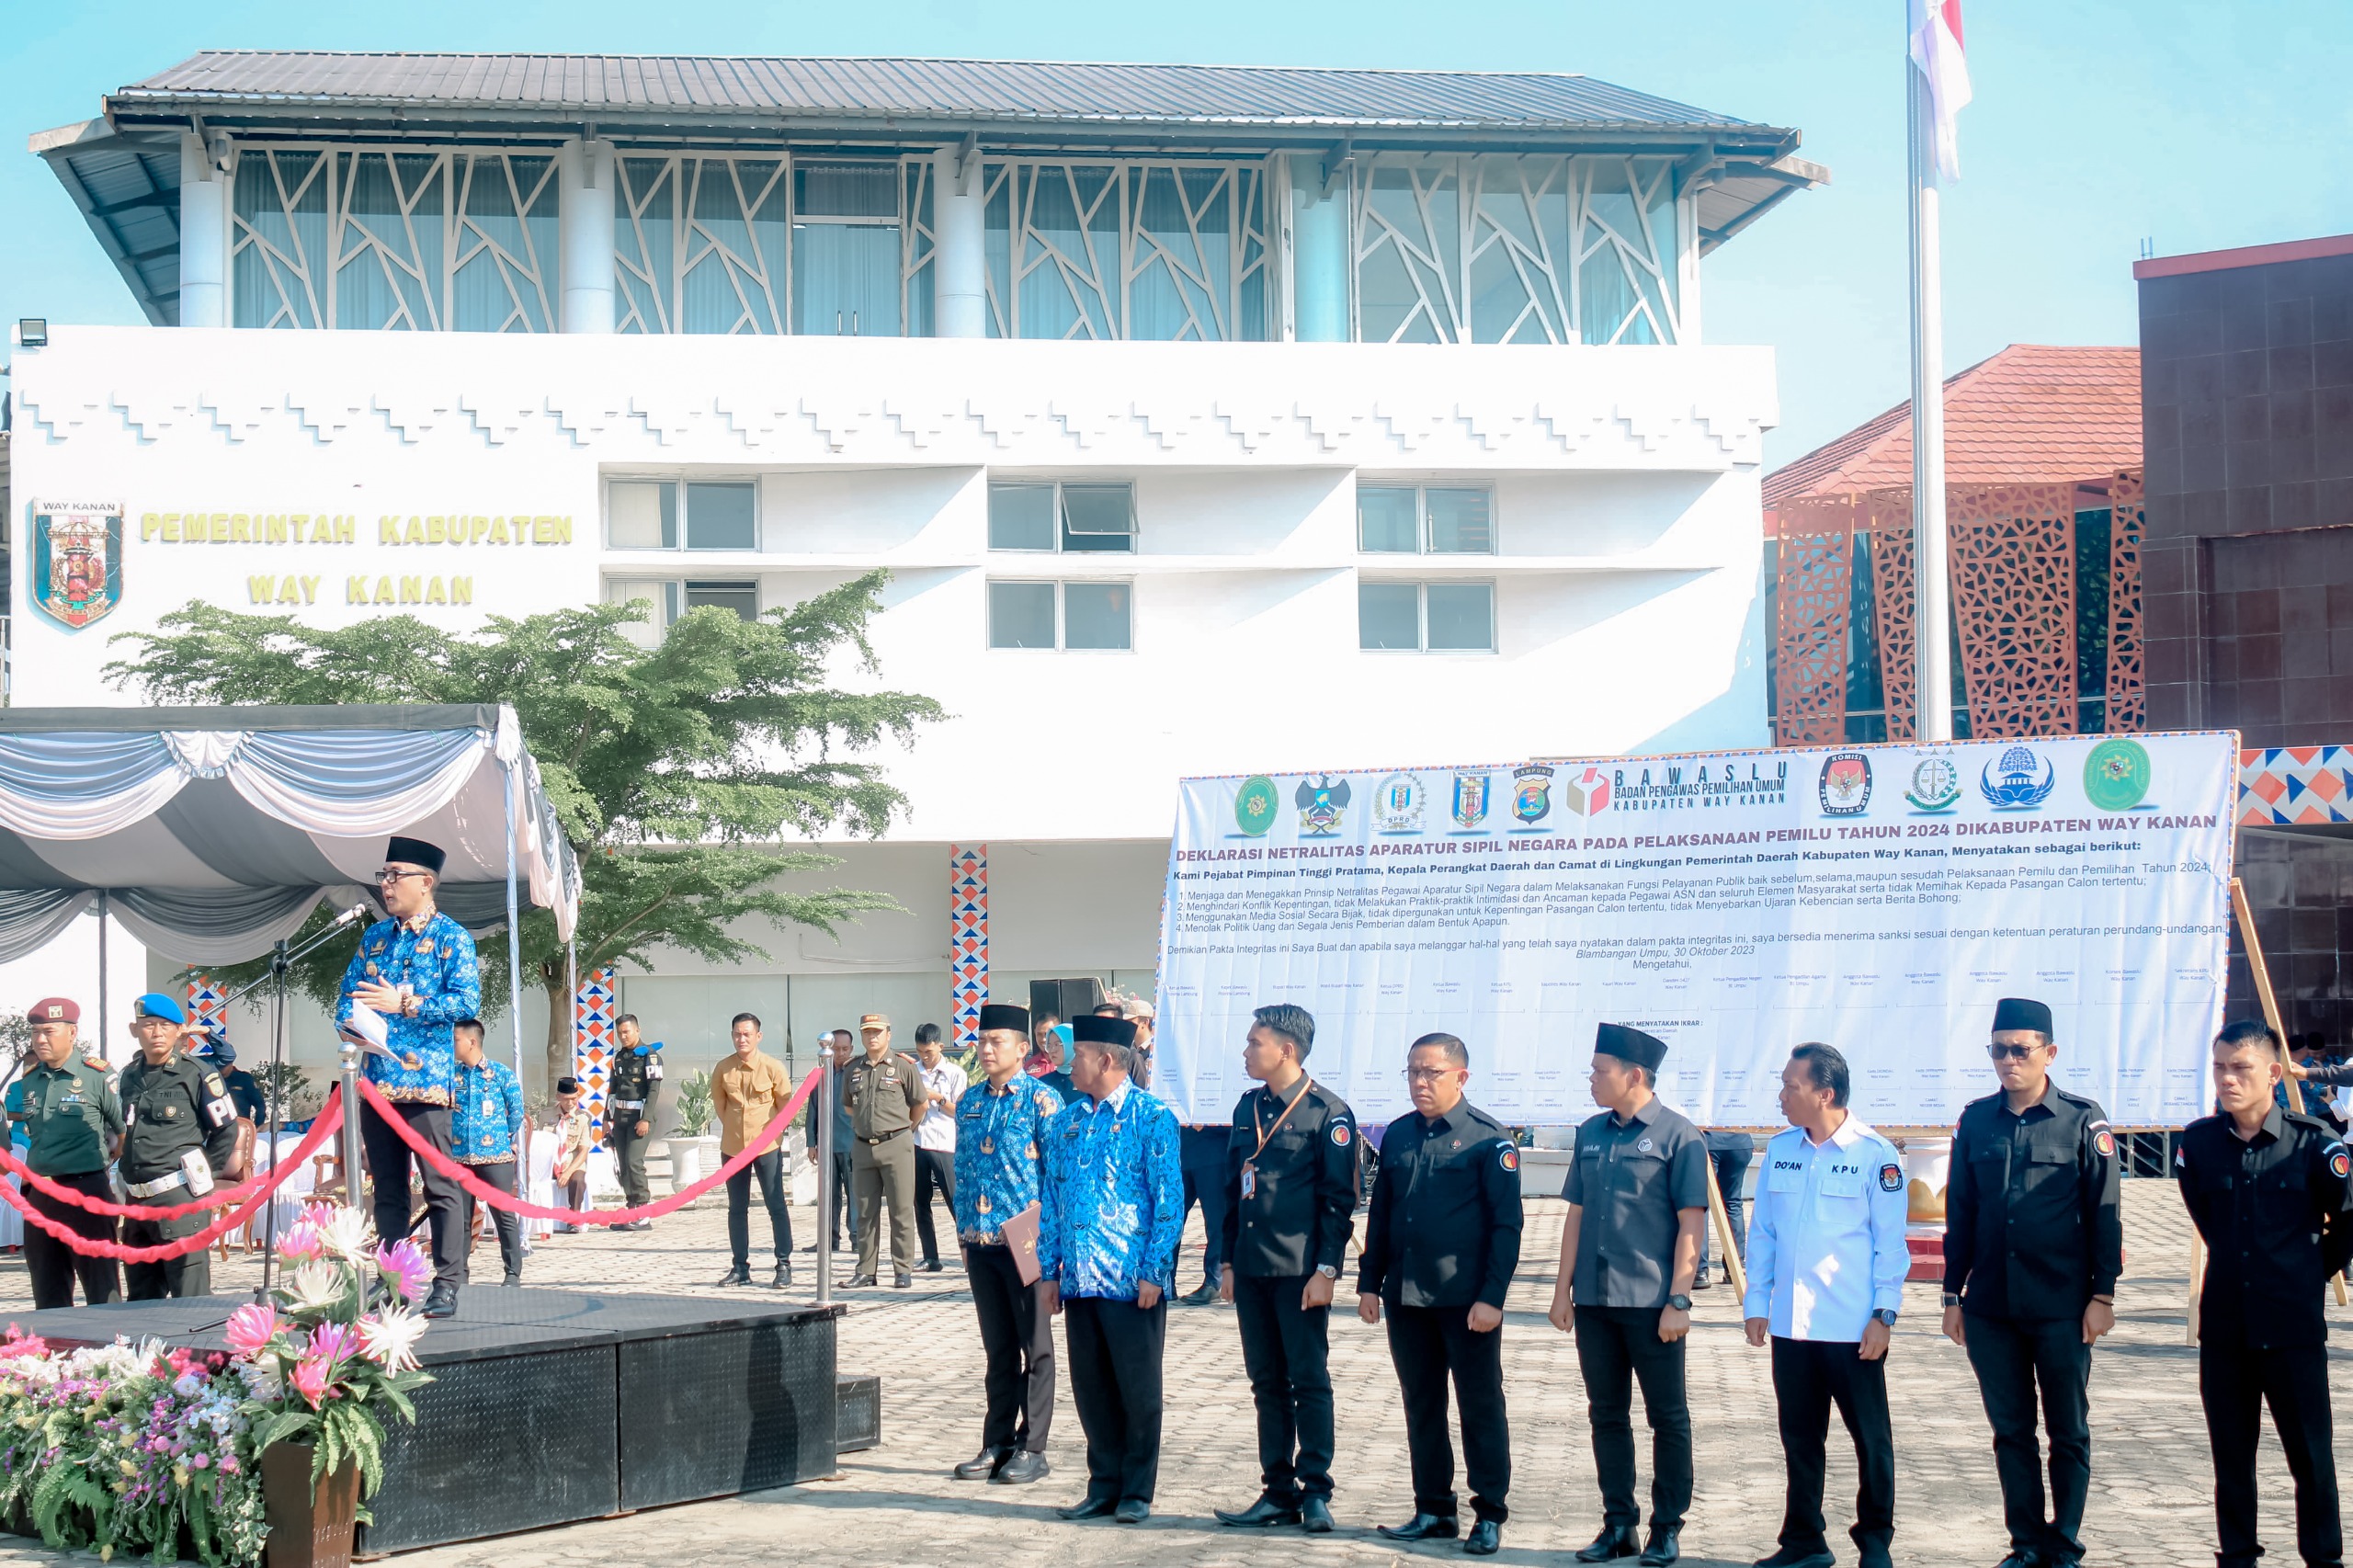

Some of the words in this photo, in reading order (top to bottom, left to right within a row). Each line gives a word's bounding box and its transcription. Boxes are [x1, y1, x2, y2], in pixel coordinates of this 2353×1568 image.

[42, 502, 69, 511] WAY
[73, 503, 116, 511] KANAN
[141, 512, 356, 543] PEMERINTAH
[379, 515, 573, 545] KABUPATEN
[247, 575, 322, 604] WAY
[347, 575, 474, 605] KANAN
[1515, 767, 1553, 777] LAMPUNG
[1832, 754, 1862, 762] KOMISI
[1614, 761, 1787, 787] BAWASLU
[1614, 797, 1694, 811] KABUPATEN
[1703, 795, 1731, 807] WAY
[1739, 792, 1785, 805] KANAN
[1615, 786, 1646, 799] BADAN
[1649, 783, 1699, 797] PENGAWAS
[1702, 780, 1753, 794] PEMILIHAN
[1756, 779, 1785, 791] UMUM
[1820, 789, 1855, 814] PEMILIHAN
[1857, 786, 1871, 812] UMUM
[1176, 848, 1263, 861] DEKLARASI
[1267, 846, 1365, 858] NETRALITAS
[1369, 843, 1457, 856] APARATUR
[1461, 841, 1503, 853] SIPIL
[1507, 838, 1577, 851] NEGARA
[1583, 837, 1629, 849] PADA
[1634, 832, 1760, 847] PELAKSANAAN
[1766, 829, 1832, 842] PEMILU
[1837, 826, 1902, 839] TAHUN
[1906, 824, 1950, 837] 2024
[1956, 820, 2091, 835] DIKABUPATEN
[2097, 818, 2141, 830] WAY
[2147, 816, 2217, 829] KANAN
[1173, 871, 1200, 880] Kami
[1203, 868, 1244, 881] Pejabat
[1246, 867, 1296, 881] Pimpinan
[1299, 866, 1332, 879] Tinggi
[1335, 864, 1384, 877] Pratama,
[1387, 863, 1427, 877] Kepala
[1429, 861, 1487, 875] Perangkat
[1490, 860, 1530, 871] Daerah
[1533, 859, 1555, 869] dan
[1558, 858, 1597, 869] Camat
[1614, 856, 1682, 870] Lingkungan
[1686, 853, 1753, 865] Pemerintah
[1756, 851, 1799, 862] Daerah
[1802, 848, 1870, 863] Kabupaten
[1873, 847, 1900, 861] Way
[1904, 846, 1948, 858] Kanan,
[1951, 843, 2030, 858] Menyatakan
[2034, 841, 2086, 855] sebagai
[2090, 840, 2142, 851] berikut:
[1187, 901, 1240, 913] Menghindari
[1243, 900, 1271, 909] Konflik
[1335, 898, 1355, 907] tidak
[1358, 896, 1406, 906] Melakukan
[1409, 895, 1473, 908] Praktik-praktik
[1476, 894, 1519, 903] Intimidasi
[1543, 892, 1588, 902] Ancaman
[1591, 891, 1626, 903] kepada
[1629, 890, 1670, 903] Pegawai
[1673, 889, 1696, 898] ASN
[1720, 887, 1755, 897] seluruh
[1757, 886, 1794, 896] Elemen
[1798, 884, 1857, 897] Masyarakat
[1888, 882, 1912, 892] tidak
[1915, 881, 1962, 891] Memihak
[1966, 880, 2006, 892] Kepada
[2010, 878, 2063, 891] Pasangan
[2067, 877, 2098, 886] Calon
[1188, 890, 1224, 903] Menjaga
[1245, 888, 1302, 901] Menegakkan
[1304, 887, 1334, 899] Prinsip
[1336, 886, 1379, 896] Netralitas
[1381, 885, 1420, 897] Pegawai
[1423, 884, 1461, 896] Aparatur
[1465, 883, 1484, 895] Sipil
[1486, 882, 1520, 894] Negara
[1555, 880, 1624, 891] Melaksanakan
[1627, 879, 1659, 891] Fungsi
[1662, 877, 1712, 890] Pelayanan
[1716, 876, 1745, 885] Publik
[1901, 869, 1944, 880] sesudah
[1947, 867, 2015, 878] Pelaksanaan
[2018, 866, 2054, 876] Pemilu
[2082, 864, 2134, 874] Pemilihan
[2143, 863, 2177, 872] Tahun
[1186, 911, 1247, 924] Menggunakan
[1249, 910, 1276, 920] Media
[1279, 910, 1305, 919] Sosial
[1308, 909, 1339, 918] Secara
[1369, 908, 1390, 917] tidak
[1392, 906, 1454, 919] dipergunakan
[1484, 904, 1543, 917] Kepentingan
[1546, 903, 1594, 915] Pasangan
[1597, 903, 1625, 912] Calon
[1670, 901, 1692, 910] tidak
[1696, 898, 1761, 912] Menyebarkan
[1765, 897, 1796, 910] Ujaran
[1800, 895, 1853, 906] Kebencian
[1885, 893, 1915, 903] Berita
[1185, 923, 1221, 932] Menolak
[1223, 922, 1249, 931] Politik
[1253, 921, 1276, 933] Uang
[1297, 920, 1328, 932] Segala
[1330, 920, 1354, 929] Jenis
[1356, 918, 1404, 928] Pemberian
[1438, 917, 1469, 926] Bentuk
[1167, 945, 1208, 954] Demikian
[1210, 944, 1234, 953] Pakta
[1236, 943, 1277, 955] Integritas
[1291, 942, 1314, 954] Saya
[1316, 942, 1337, 951] Buat
[1358, 941, 1392, 953] apabila
[1418, 939, 1467, 952] melanggar
[1469, 939, 1500, 949] hal-hal
[1580, 937, 1624, 949] nyatakan
[1658, 936, 1686, 948] pakta
[1688, 934, 1733, 947] integritas
[1778, 932, 1821, 942] bersedia
[1824, 931, 1875, 940] menerima
[1878, 930, 1911, 939] sanksi
[1914, 929, 1948, 938] sesuai
[1949, 927, 1990, 940] dengan
[1993, 926, 2046, 937] ketentuan
[2049, 926, 2100, 937] peraturan
[1575, 949, 1637, 960] Blambangan
[1675, 947, 1687, 956] 30
[1689, 946, 1728, 956] Oktober
[1731, 945, 1756, 955] 2023
